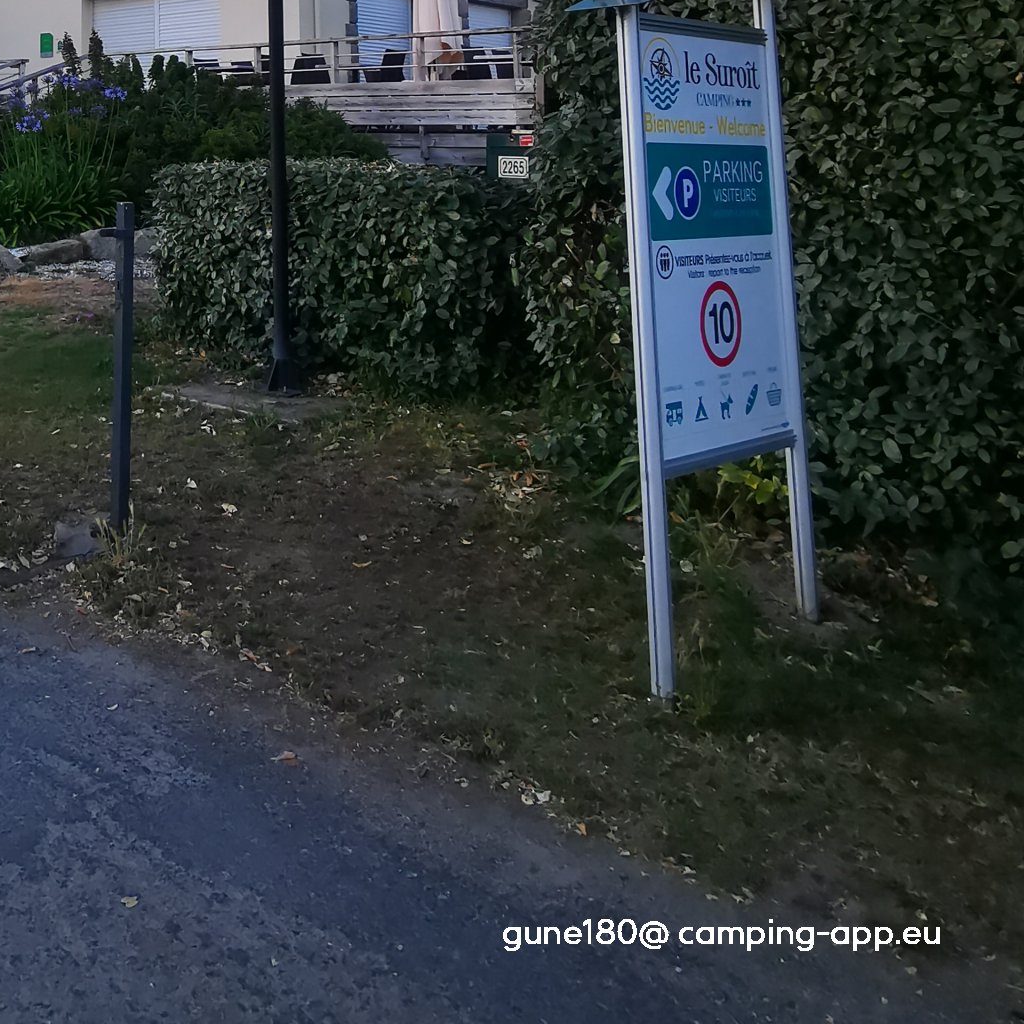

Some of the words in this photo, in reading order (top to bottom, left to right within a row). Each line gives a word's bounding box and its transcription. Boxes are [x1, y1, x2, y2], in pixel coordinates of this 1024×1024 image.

[683, 50, 700, 85] le
[704, 52, 760, 90] Suroît
[696, 92, 734, 108] CAMPING
[644, 111, 706, 135] Bienvenue
[716, 115, 766, 137] Welcome
[502, 160, 525, 174] 2265
[703, 160, 763, 184] PARKING
[682, 178, 694, 208] P
[713, 187, 756, 203] VISITEURS
[675, 255, 704, 267] VISITEURS
[708, 301, 735, 345] 10
